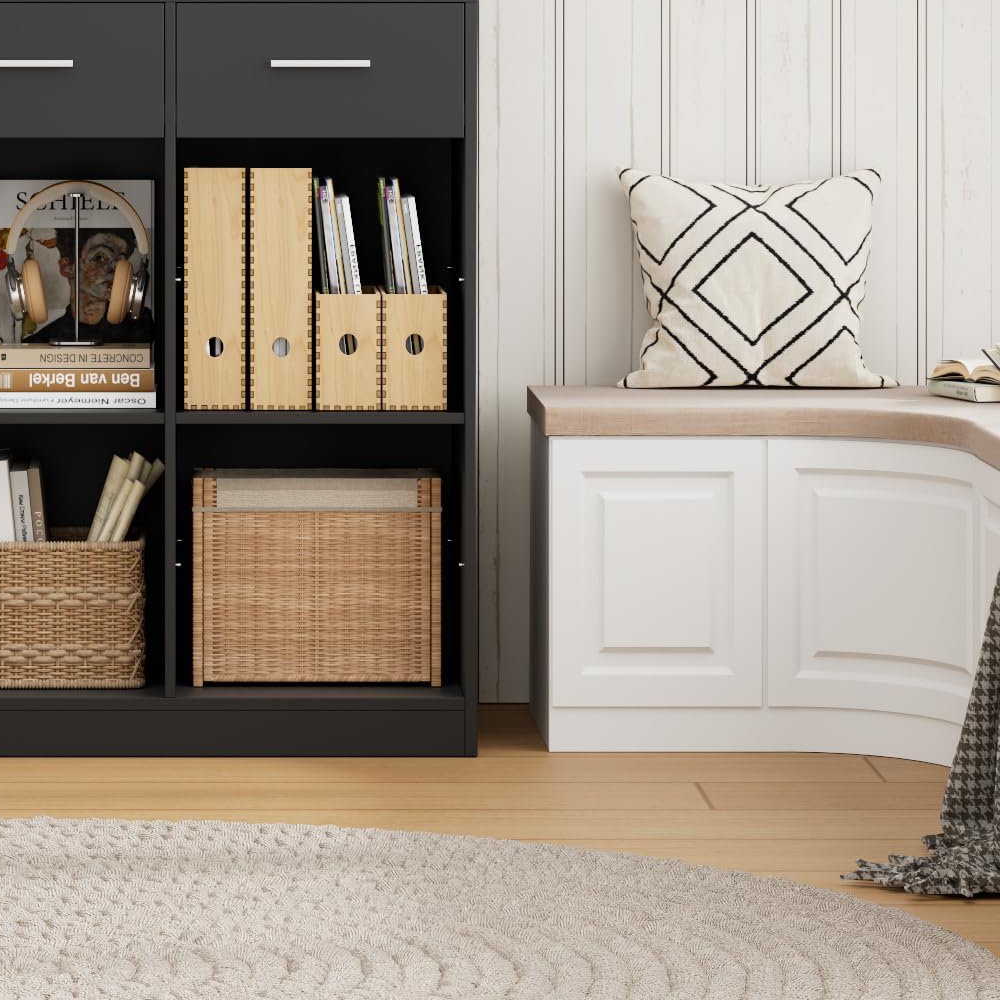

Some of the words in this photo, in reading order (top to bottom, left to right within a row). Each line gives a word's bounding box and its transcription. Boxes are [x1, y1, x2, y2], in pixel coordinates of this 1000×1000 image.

[40, 353, 76, 362] DESIGN
[79, 353, 88, 362] IN
[90, 353, 144, 362] CONCRETE
[28, 373, 76, 388] Berkel
[80, 373, 107, 385] van
[112, 373, 140, 388] Ben
[56, 396, 109, 404] Niemeyer
